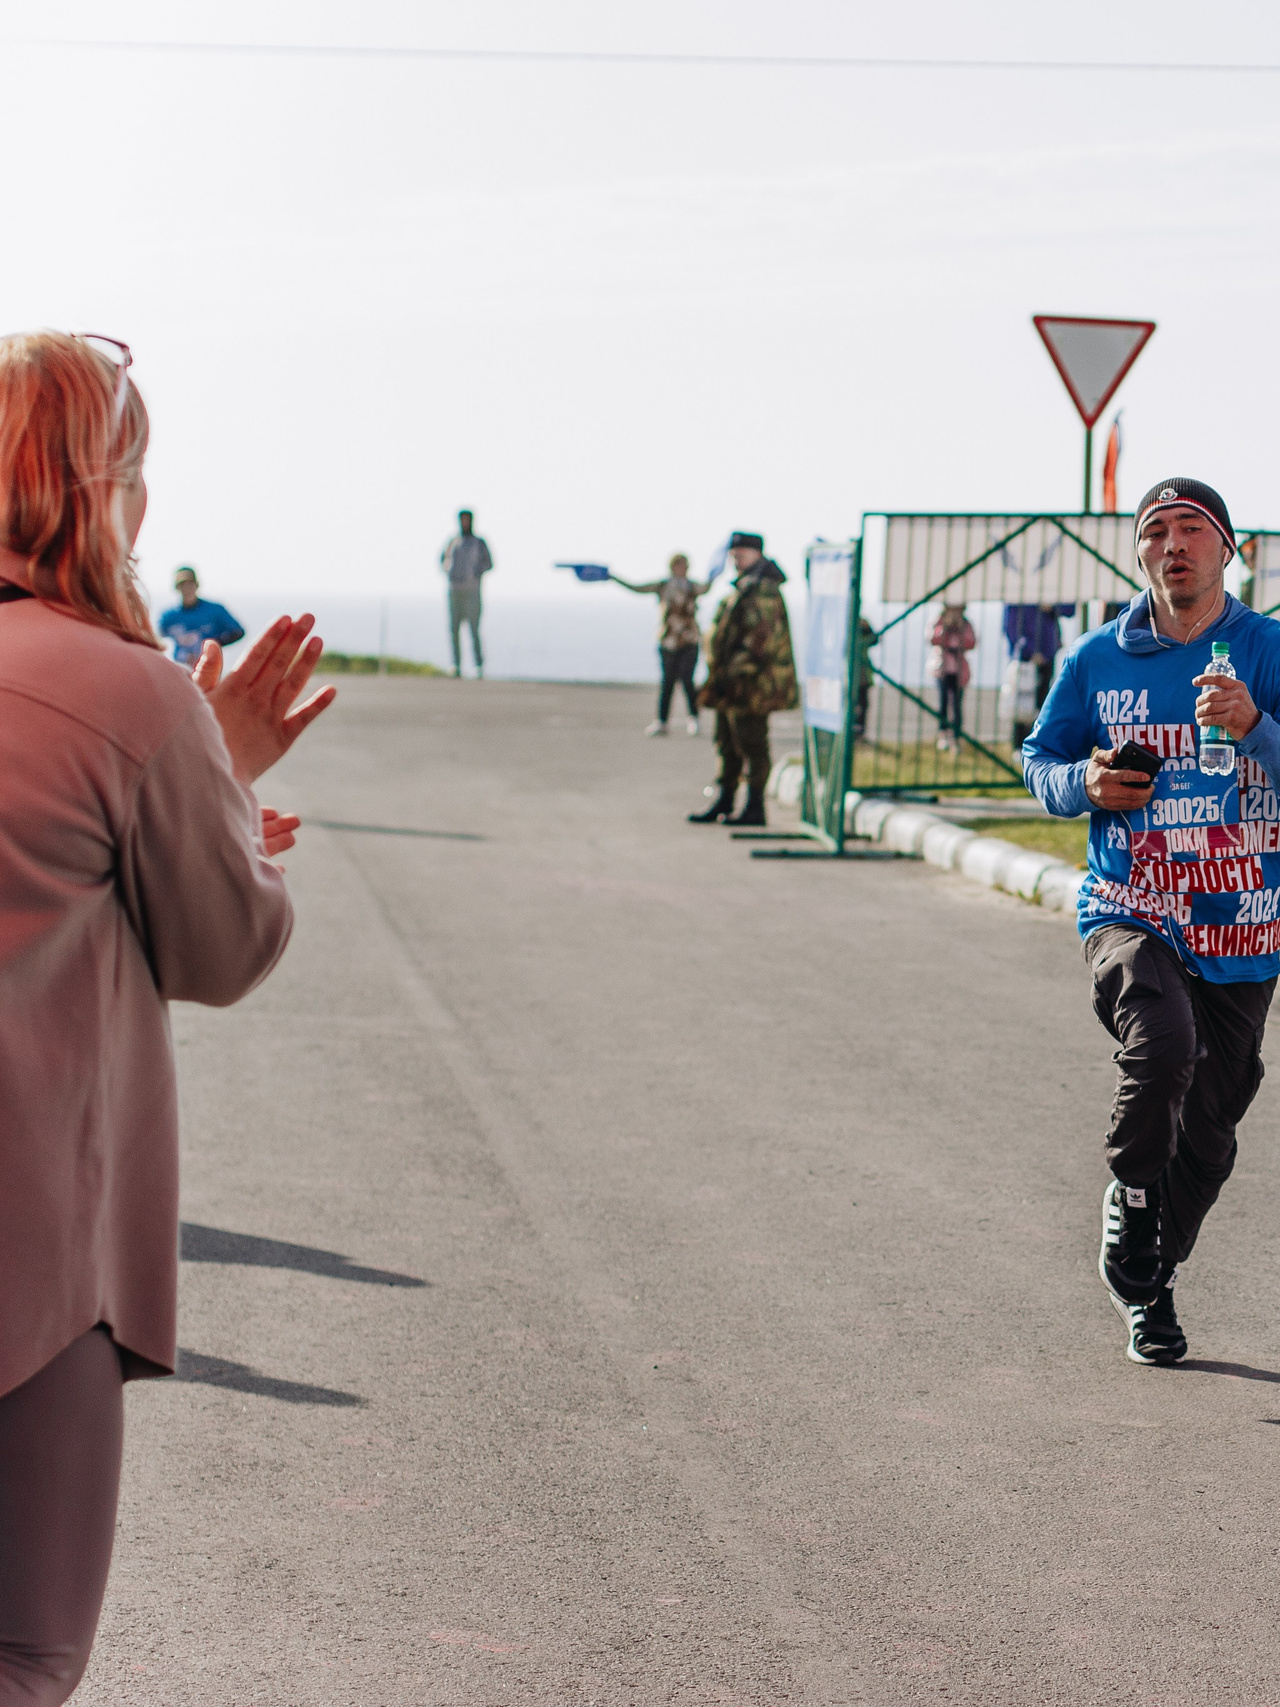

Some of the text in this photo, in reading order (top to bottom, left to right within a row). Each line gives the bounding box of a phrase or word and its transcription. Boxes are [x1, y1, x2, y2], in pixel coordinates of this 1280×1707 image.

[1096, 689, 1150, 724] 2024
[1152, 795, 1220, 826] 30025
[1235, 886, 1280, 924] 2024
